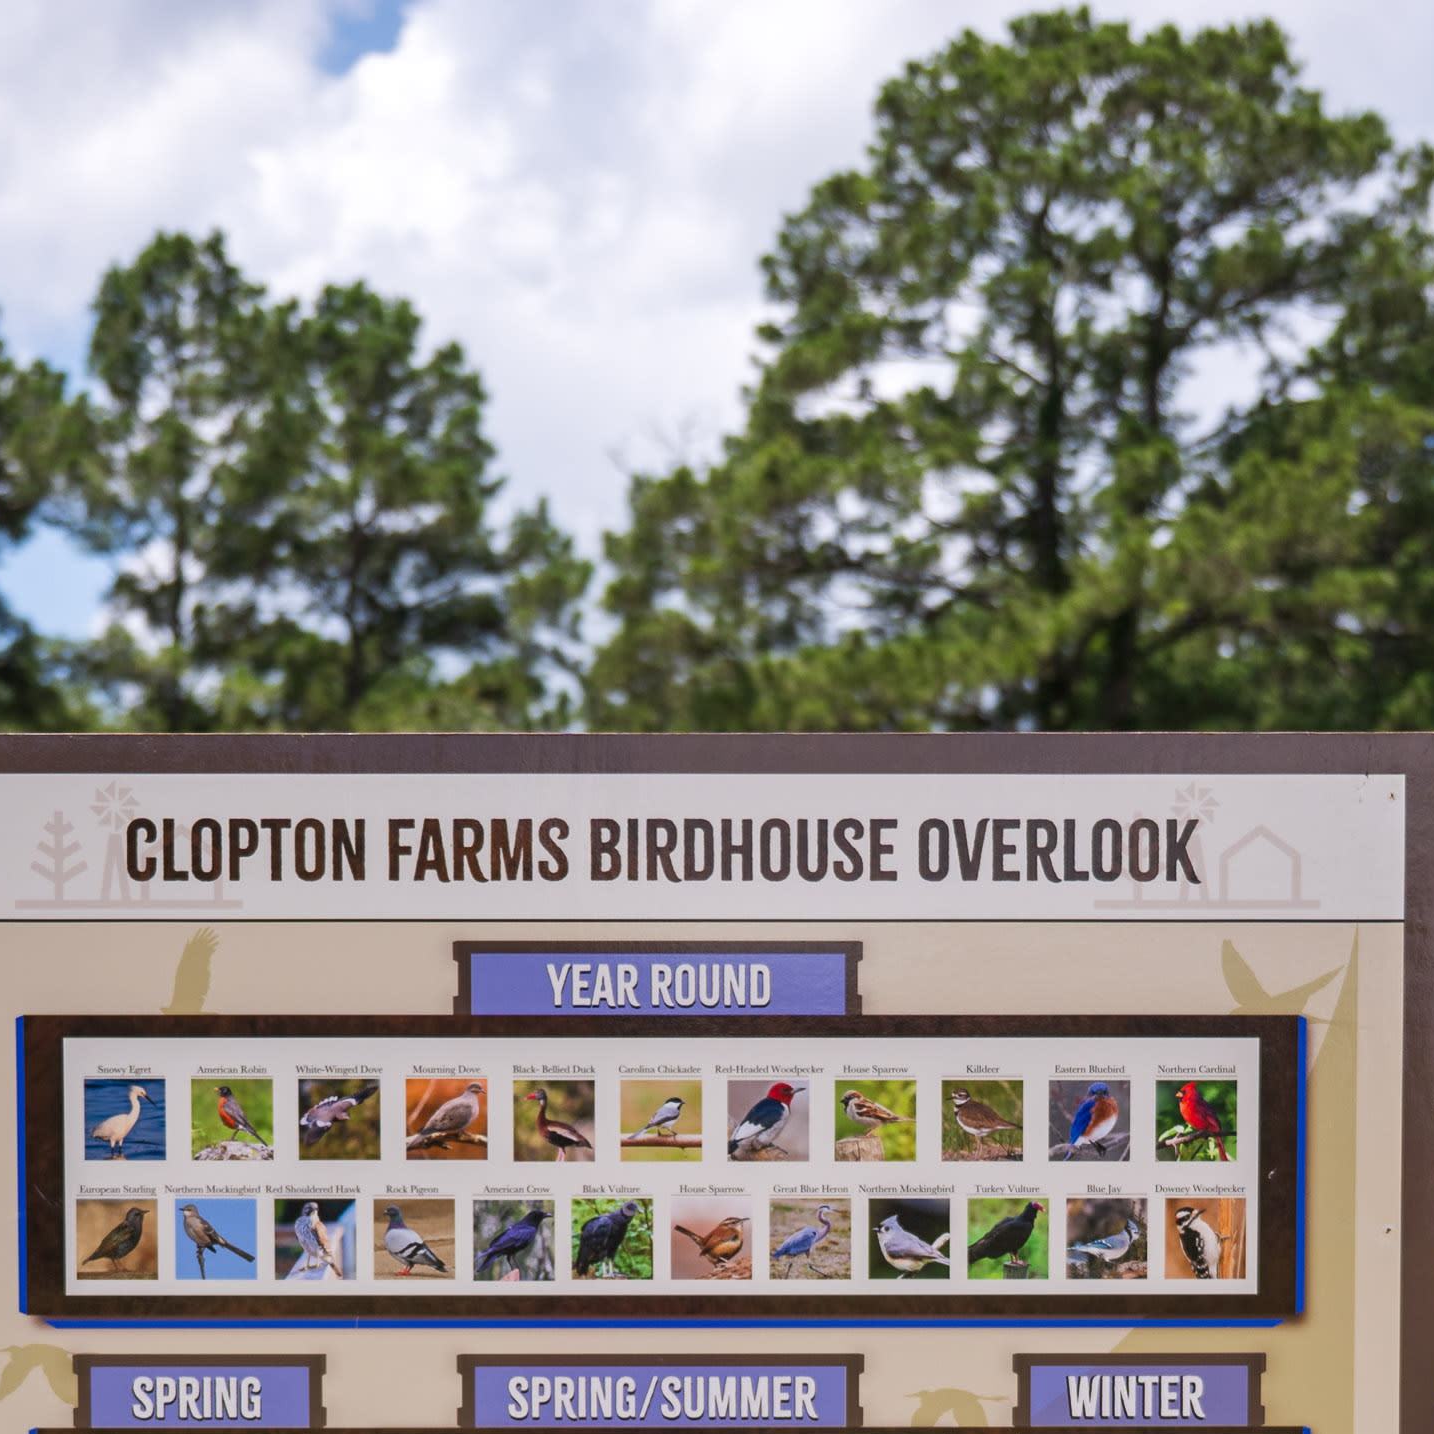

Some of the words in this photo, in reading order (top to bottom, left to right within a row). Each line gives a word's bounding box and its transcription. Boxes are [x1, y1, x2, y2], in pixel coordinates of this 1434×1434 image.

[126, 818, 367, 881] CLOPTON
[389, 818, 570, 881] FARMS
[589, 818, 899, 882] BIRDHOUSE
[918, 818, 1202, 884] OVERLOOK
[546, 964, 641, 1008] YEAR
[650, 964, 772, 1008] ROUND
[97, 1065, 126, 1075] Snowy
[129, 1065, 152, 1075] Egret
[197, 1066, 238, 1074] American
[241, 1065, 267, 1074] Robin
[295, 1065, 358, 1075] White-Winged
[360, 1065, 383, 1073] Dove
[412, 1065, 456, 1075] Mourning
[458, 1065, 481, 1073] Dove
[542, 1065, 571, 1073] Bellied
[574, 1065, 596, 1073] Duck
[618, 1065, 655, 1073] Carolina
[657, 1065, 702, 1073] Chickadee
[715, 1065, 769, 1073] Red-Headed
[771, 1065, 824, 1075] Woodpecker
[843, 1065, 870, 1073] House
[872, 1065, 908, 1075] Sparrow
[966, 1065, 1000, 1073] Killdeer
[1054, 1065, 1087, 1073] Eastern
[1088, 1065, 1125, 1073] Bluebird
[1157, 1065, 1197, 1073] Northern
[1199, 1065, 1236, 1073] Cardinal
[79, 1184, 121, 1194] European
[123, 1185, 157, 1194] Starling
[164, 1185, 204, 1193] Northern
[206, 1185, 261, 1194] Mockingbird
[265, 1185, 283, 1193] Red
[285, 1185, 333, 1193] Shouldered
[335, 1185, 361, 1193] Hawk
[386, 1185, 408, 1193] Rock
[410, 1185, 439, 1194] Pigeon
[526, 1185, 550, 1193] Crow
[582, 1185, 606, 1193] Black
[608, 1184, 641, 1193] Vulture
[679, 1184, 706, 1193] House
[709, 1184, 745, 1194] Sparrow
[773, 1185, 798, 1193] Great
[799, 1184, 820, 1193] Blue
[821, 1184, 849, 1193] Heron
[858, 1185, 897, 1194] Northern
[899, 1184, 955, 1194] Mockingbird
[975, 1185, 1004, 1194] Turkey
[1007, 1184, 1040, 1193] Vulture
[1087, 1184, 1105, 1193] Blue
[1107, 1184, 1122, 1195] Jay
[1155, 1184, 1190, 1194] Downey
[1192, 1184, 1246, 1194] Woodpecker
[132, 1377, 263, 1420] SPRING
[507, 1377, 818, 1420] SPRING/SUMMER
[1067, 1377, 1205, 1419] WINTER
